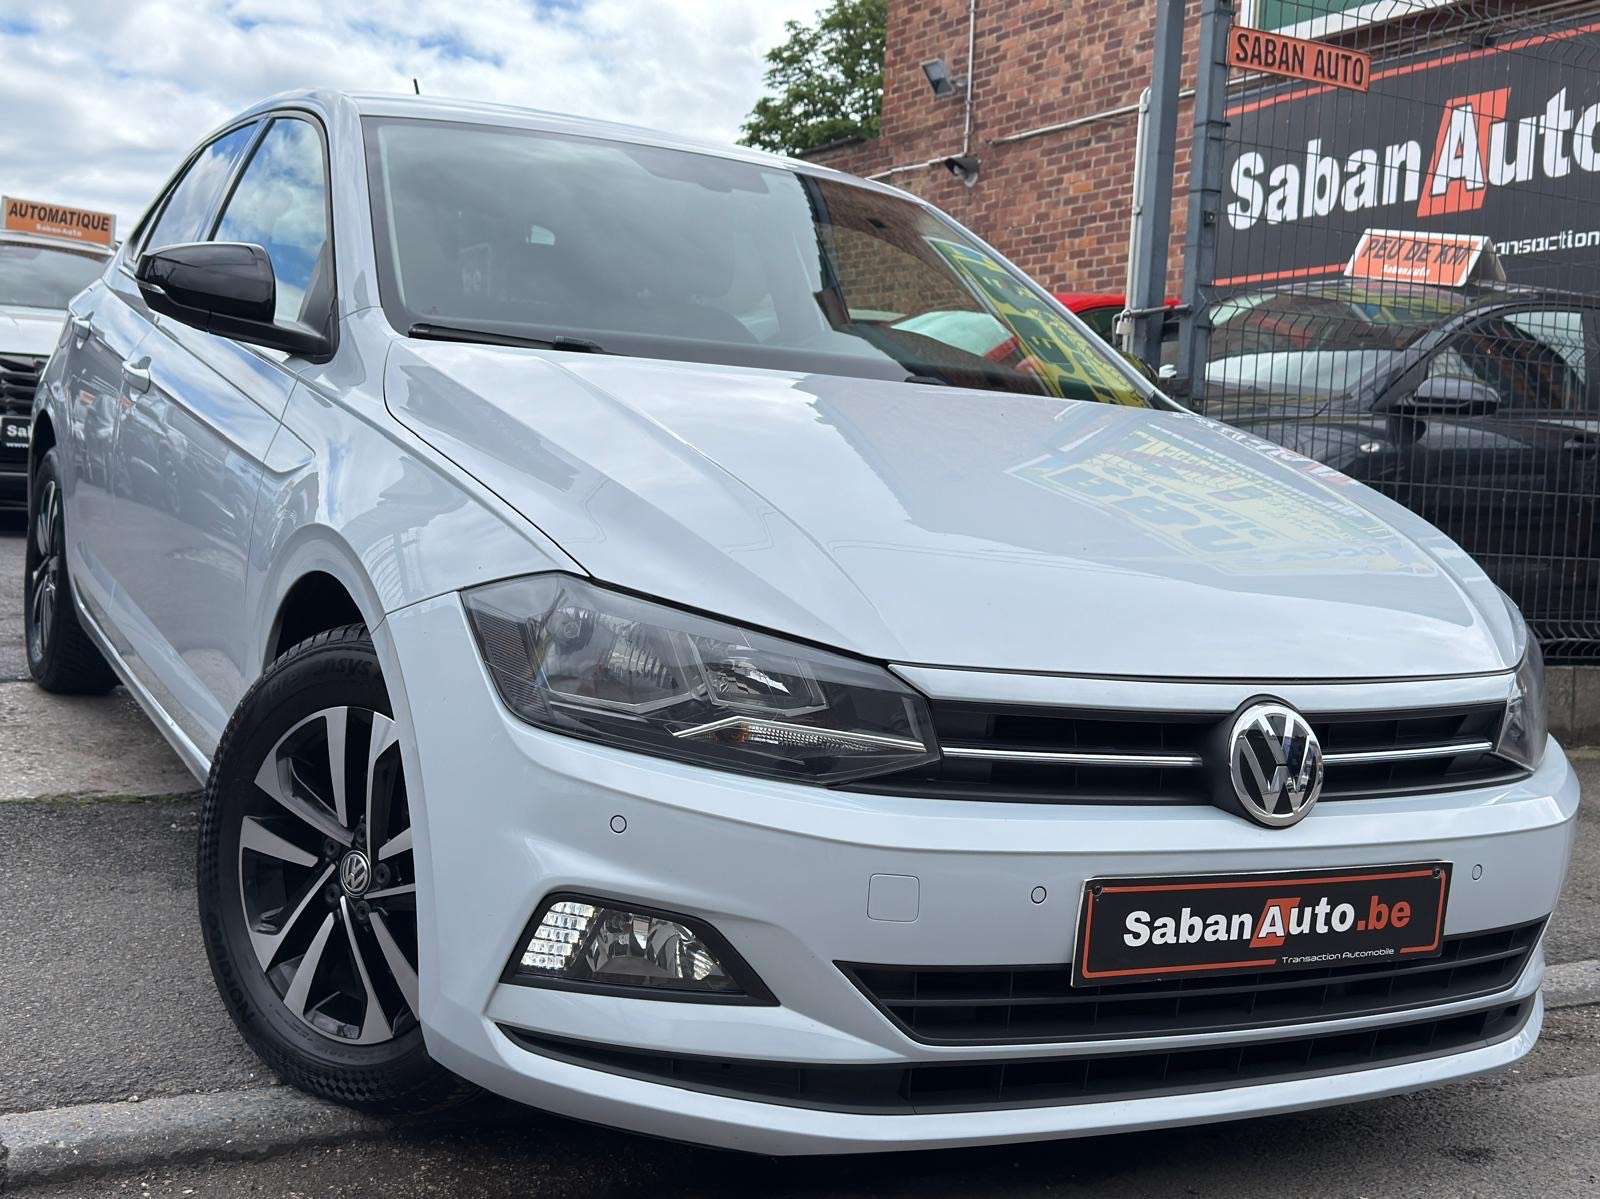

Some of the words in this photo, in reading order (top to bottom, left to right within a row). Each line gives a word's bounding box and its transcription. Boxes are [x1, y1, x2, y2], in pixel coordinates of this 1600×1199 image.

[1235, 32, 1306, 74] SABAN
[1313, 48, 1364, 85] AUTO
[9, 202, 110, 232] AUTOMATIQUE
[1361, 237, 1404, 260] PEU
[1404, 240, 1432, 263] DE
[1434, 244, 1469, 266] KM
[1494, 230, 1600, 257] ansaction
[1123, 895, 1412, 947] SabanAuto.be
[1281, 952, 1341, 964] Transaction
[1342, 947, 1395, 959] Automobile
